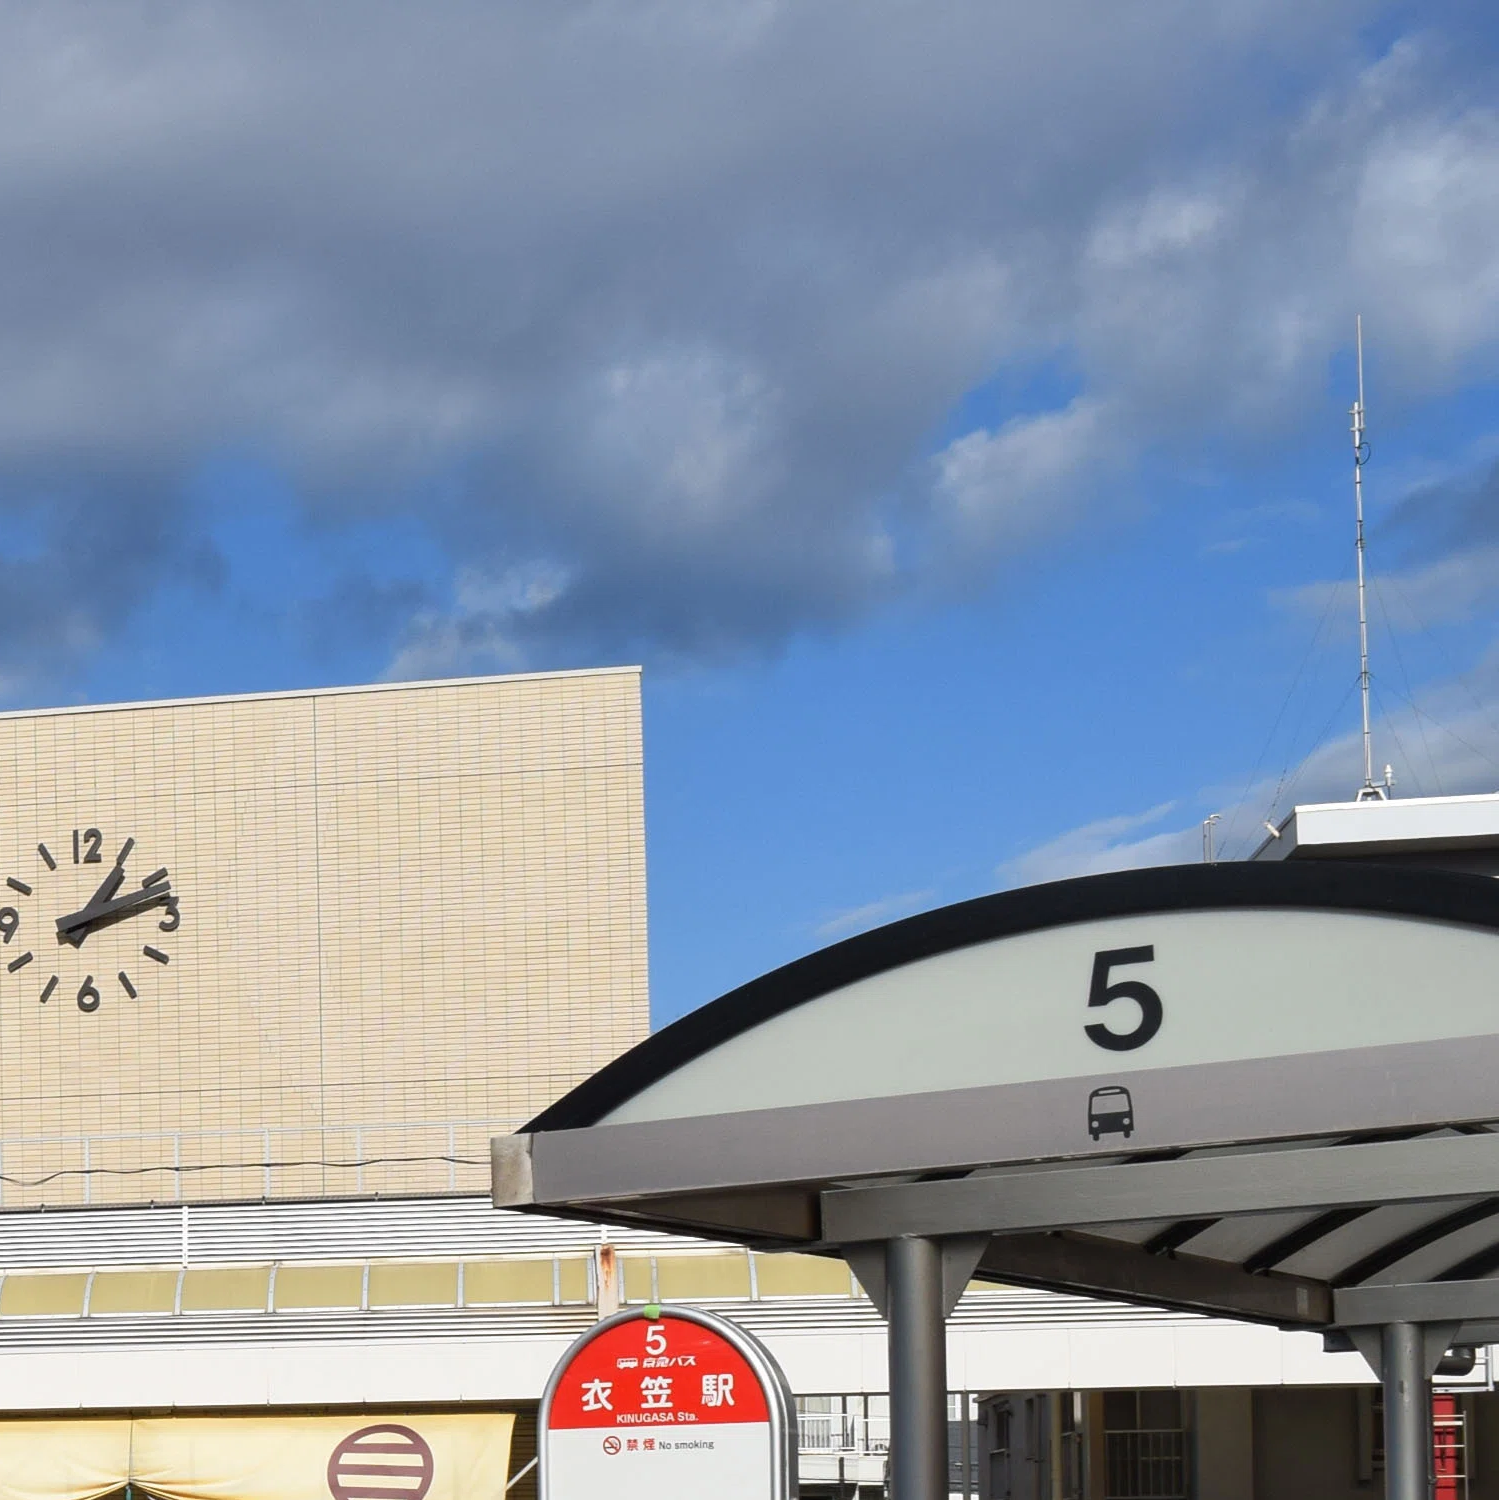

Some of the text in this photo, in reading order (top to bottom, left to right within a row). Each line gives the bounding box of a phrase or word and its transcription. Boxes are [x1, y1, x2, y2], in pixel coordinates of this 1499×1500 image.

[73, 828, 103, 864] 12
[77, 974, 101, 1013] 6
[1084, 944, 1163, 1052] 5
[645, 1325, 667, 1354] 5
[580, 1373, 735, 1412] 衣笠駅
[616, 1411, 699, 1424] KINUGASA Sta.
[626, 1438, 656, 1451] 禁煙
[659, 1438, 715, 1453] No smoking
